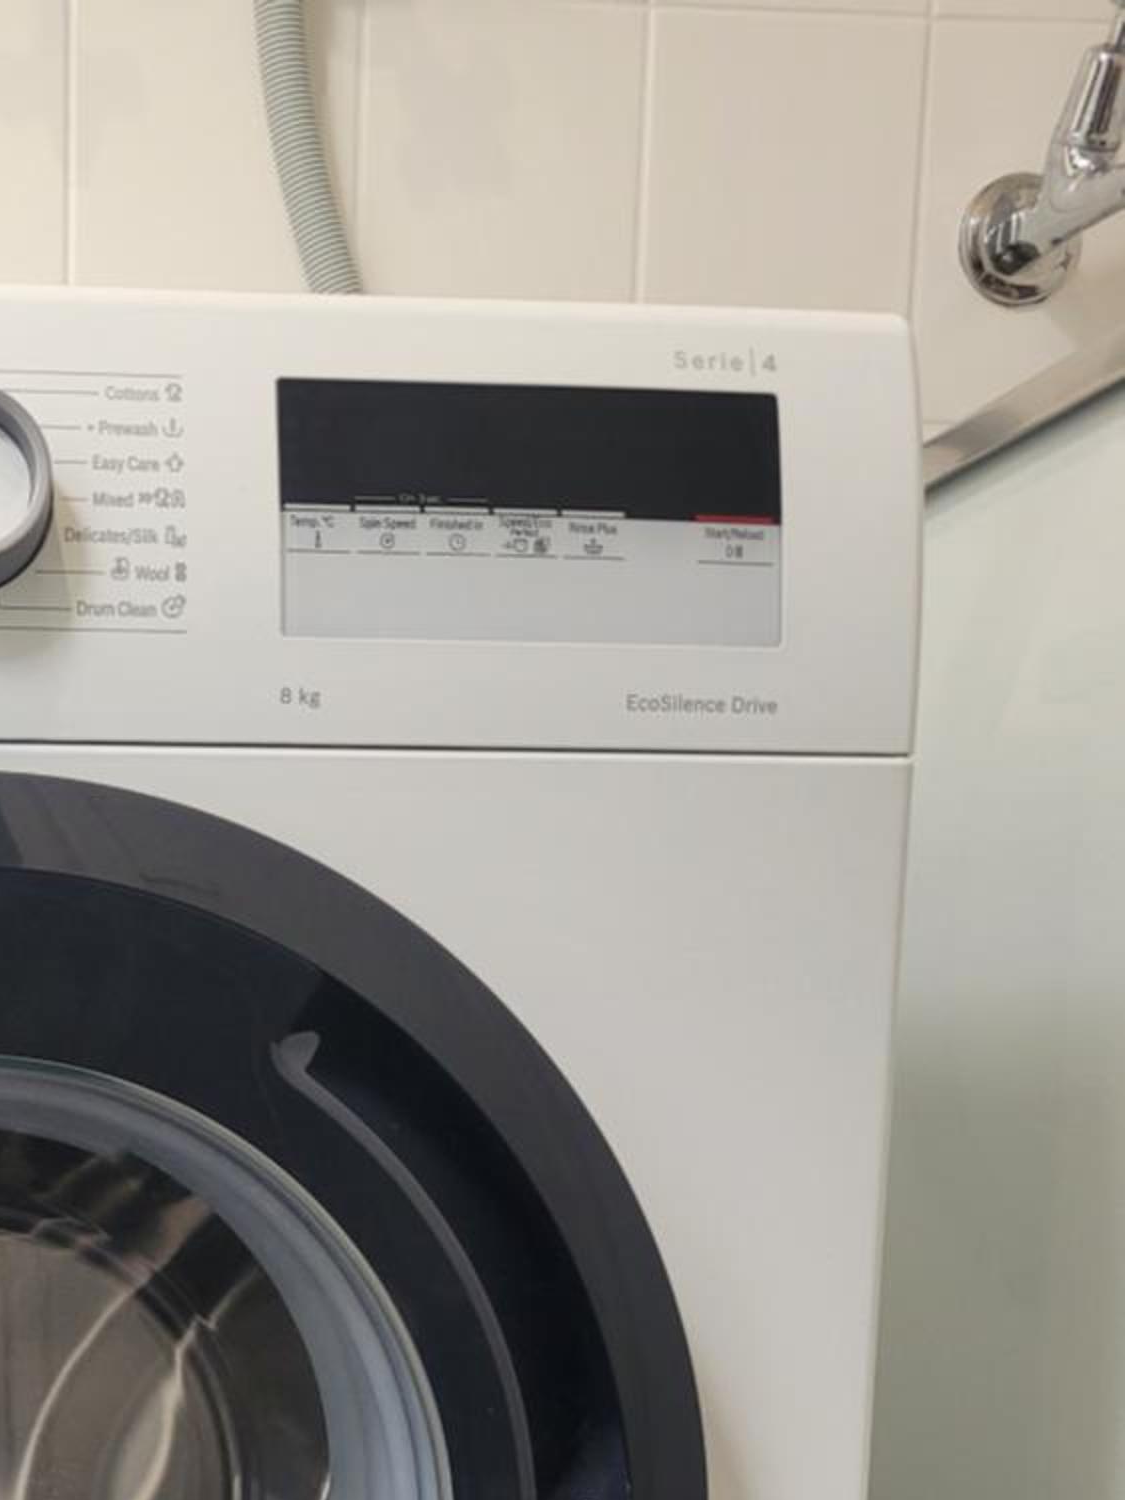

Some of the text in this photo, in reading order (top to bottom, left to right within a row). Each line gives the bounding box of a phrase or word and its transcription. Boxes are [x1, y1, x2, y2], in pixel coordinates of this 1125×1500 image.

[105, 385, 160, 402] Cottons
[98, 420, 159, 437] Prewash
[92, 454, 160, 474] Easy Care
[92, 491, 134, 508] Mixed
[64, 527, 157, 545] Delicates/Silk
[135, 564, 170, 581] Wool
[76, 600, 158, 618] Drum Clean
[280, 687, 321, 710] 8 kg
[625, 693, 778, 716] EcoSilence Drive
